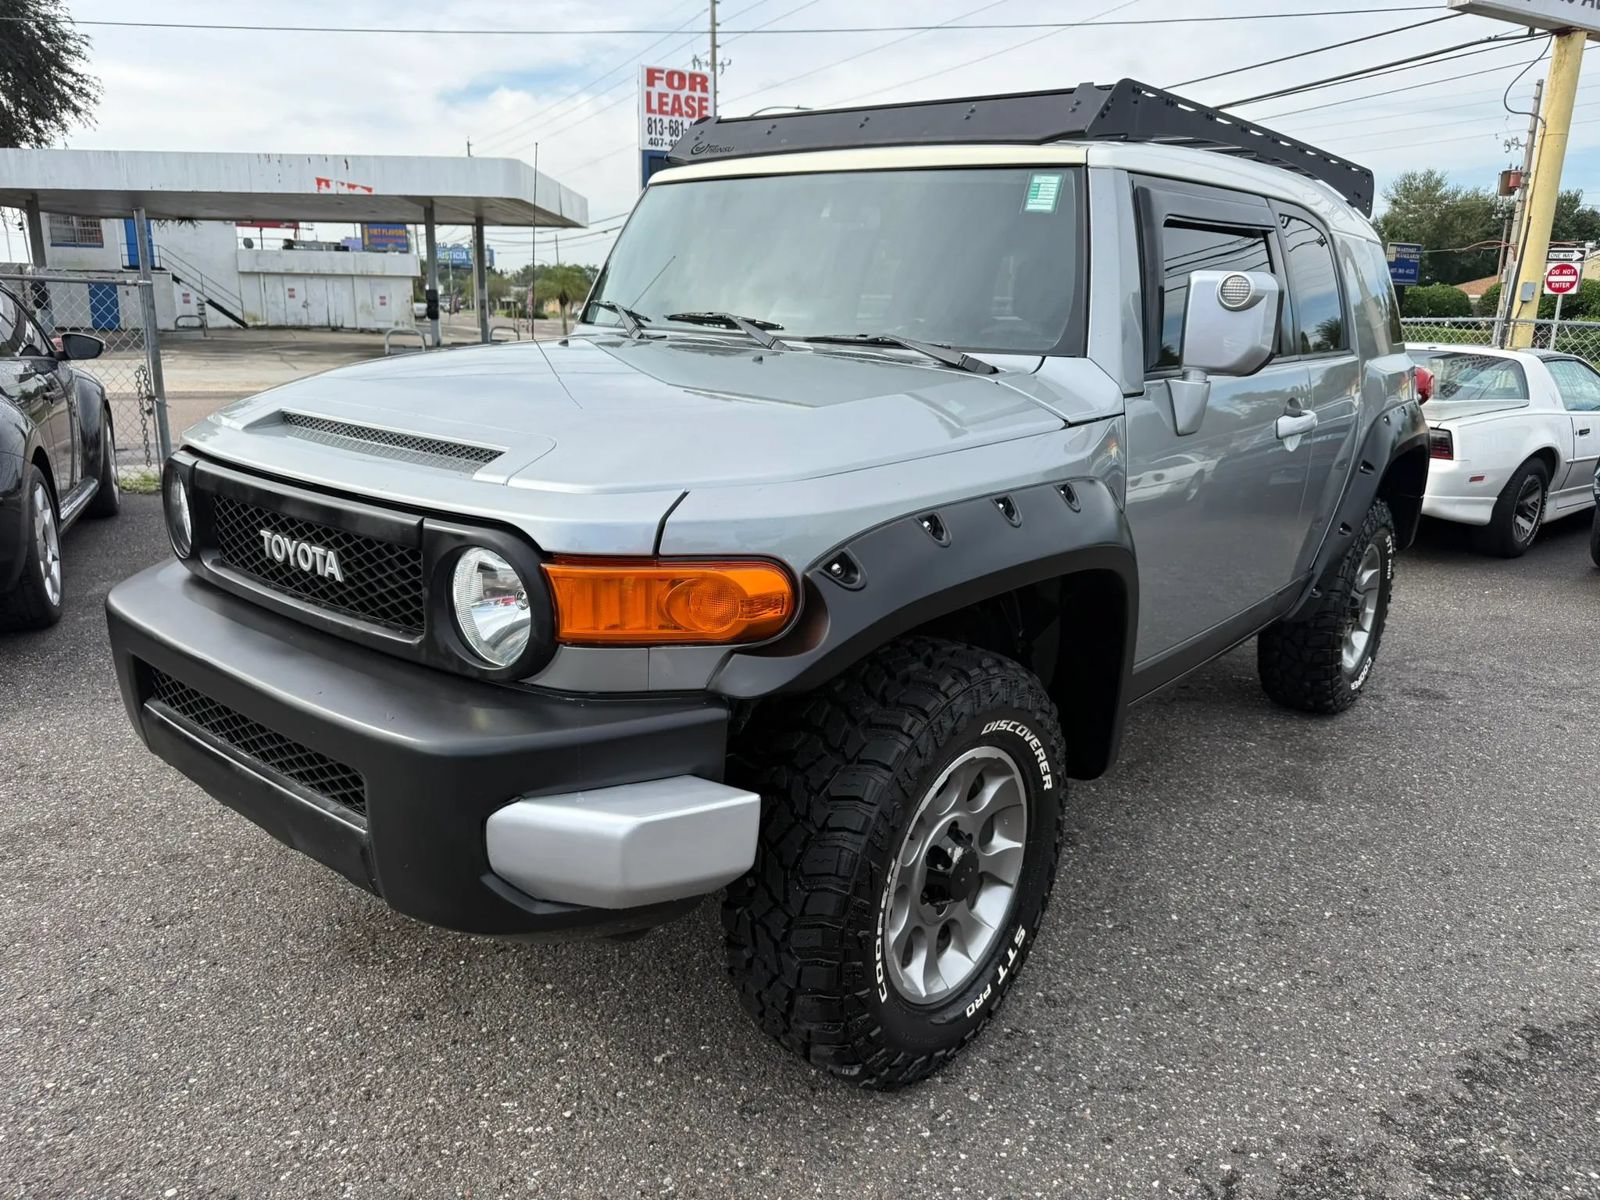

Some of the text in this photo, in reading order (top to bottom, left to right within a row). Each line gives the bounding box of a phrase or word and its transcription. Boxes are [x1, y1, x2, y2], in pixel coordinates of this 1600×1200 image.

[646, 68, 709, 93] FOR
[646, 91, 709, 118] LEASE
[260, 529, 344, 582] TOYOTA
[980, 719, 1053, 791] DISCOVERER
[965, 924, 1027, 1018] STT PRO
